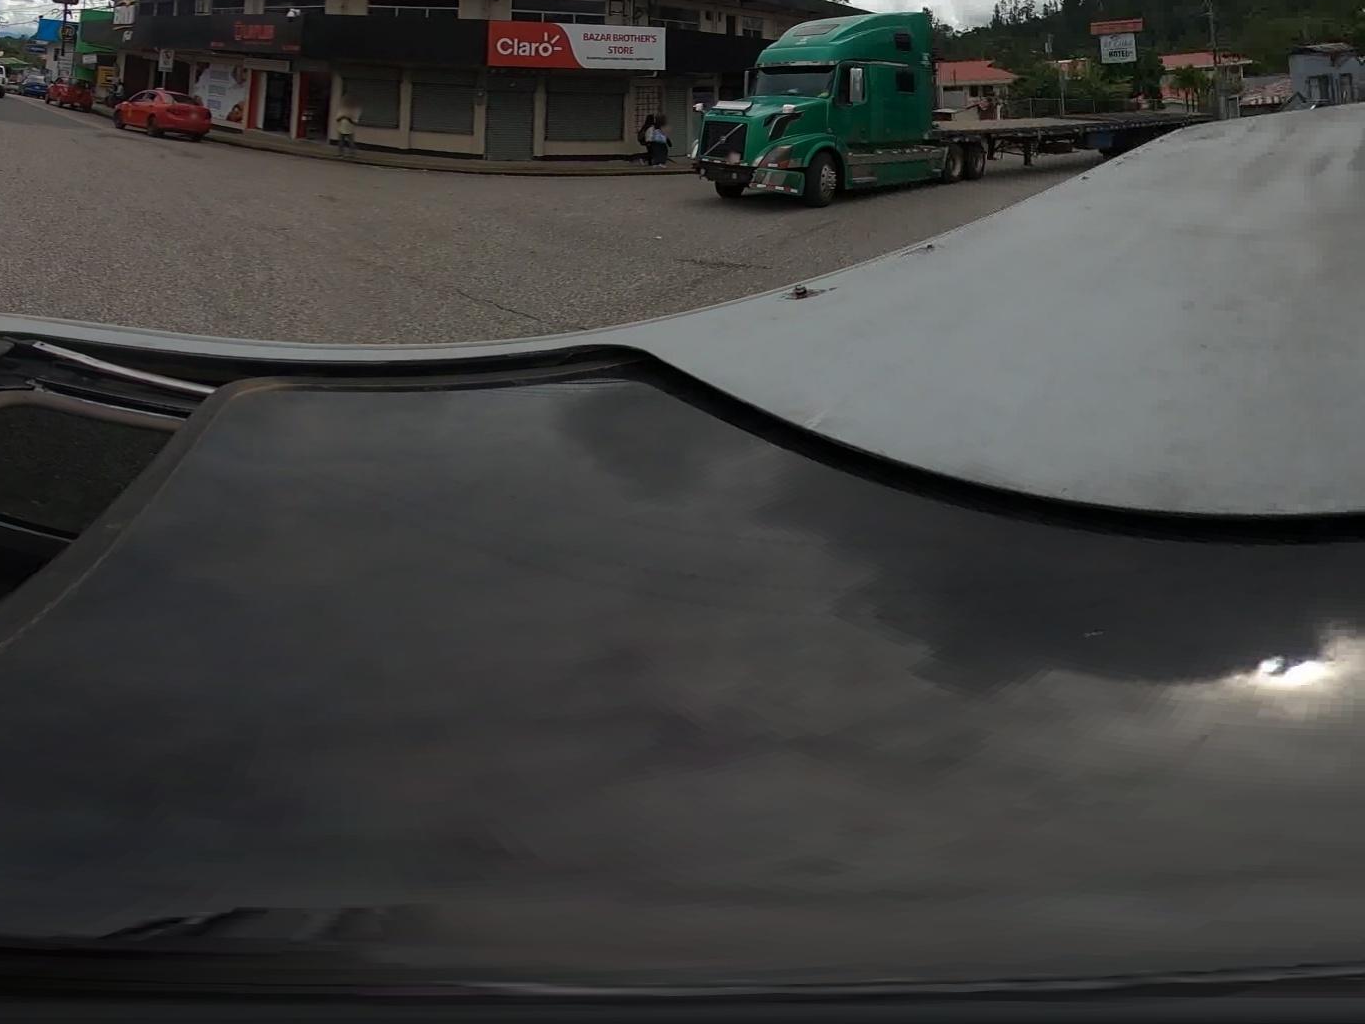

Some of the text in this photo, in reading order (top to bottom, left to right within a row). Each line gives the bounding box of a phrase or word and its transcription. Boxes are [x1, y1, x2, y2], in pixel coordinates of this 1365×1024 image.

[583, 32, 657, 43] BAZAR BROTHER'S
[496, 37, 553, 57] Claro
[607, 46, 635, 55] STORE
